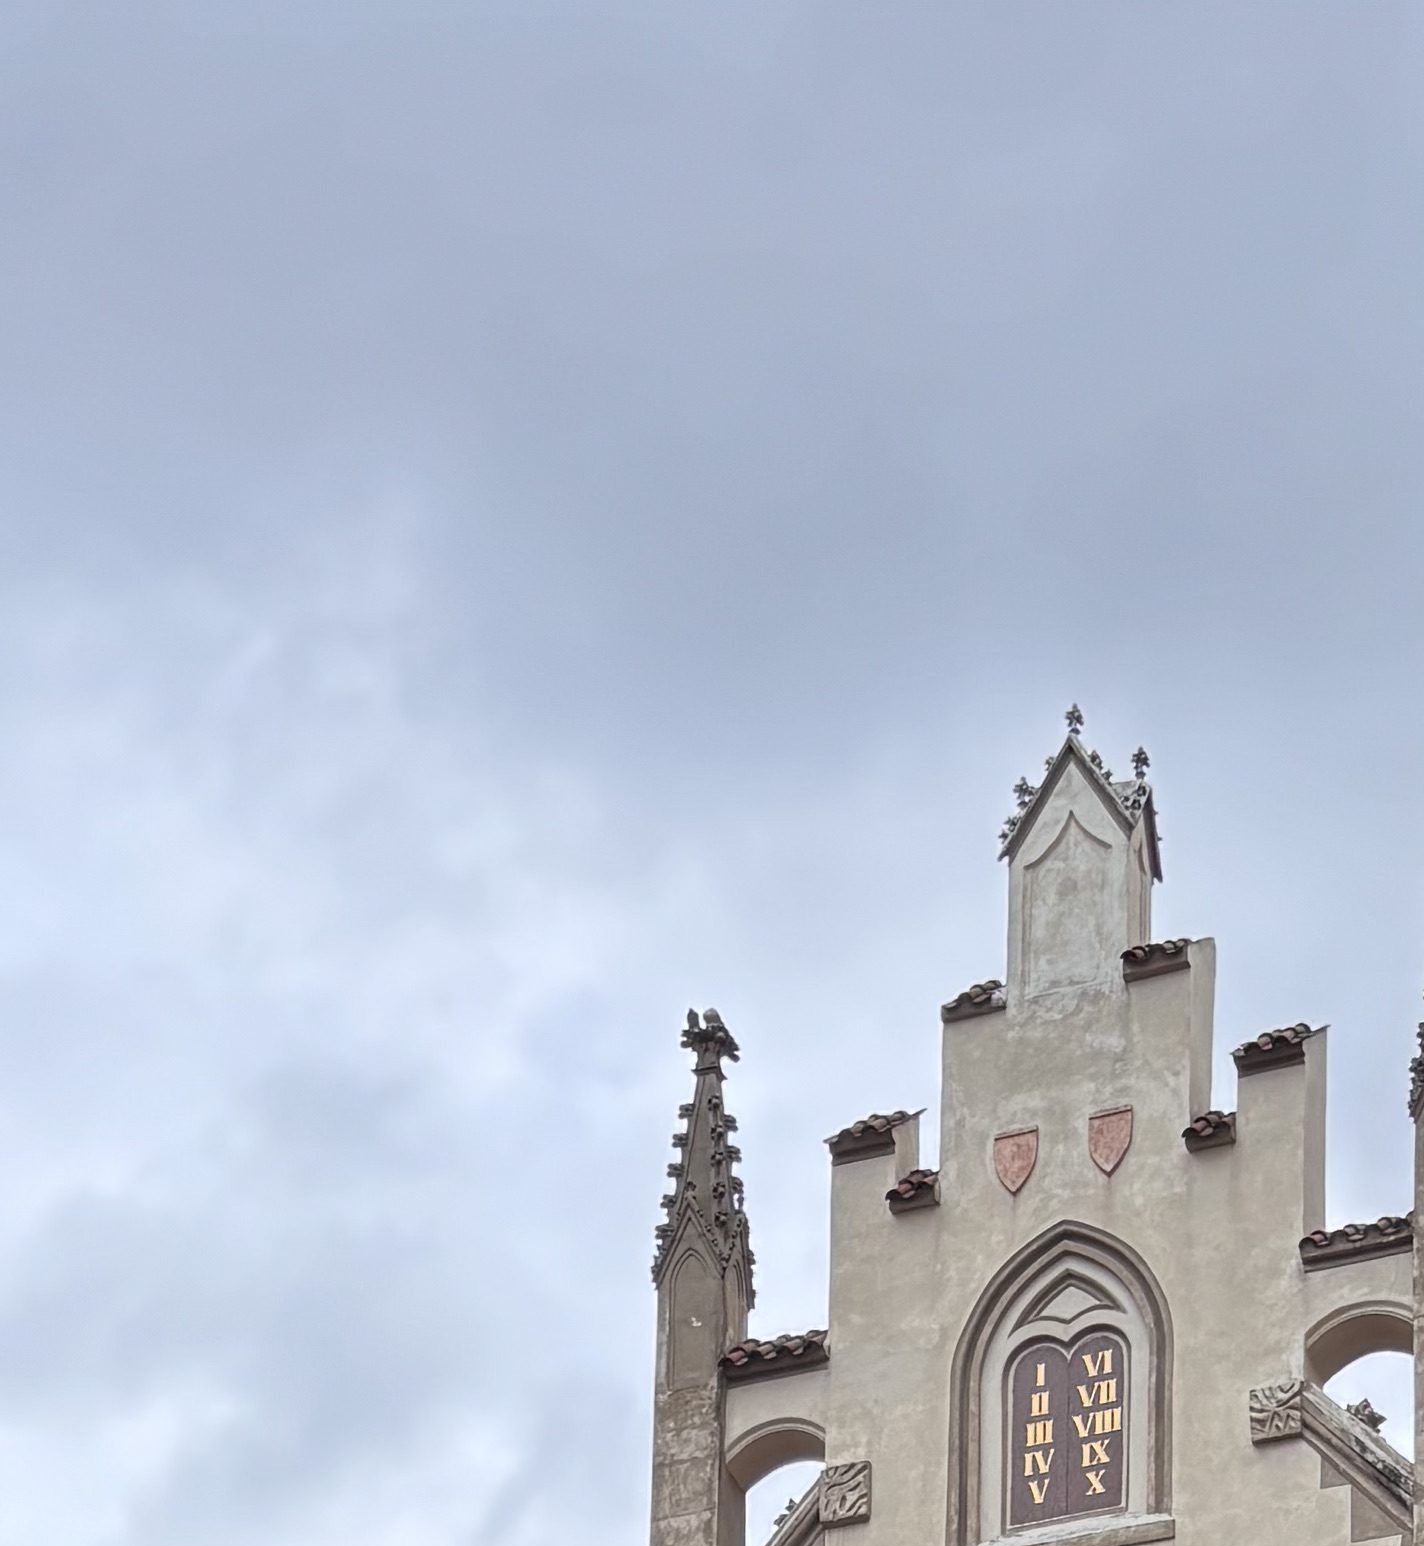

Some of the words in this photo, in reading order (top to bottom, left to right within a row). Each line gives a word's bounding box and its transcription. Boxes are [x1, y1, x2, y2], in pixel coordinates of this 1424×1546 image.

[1036, 1363, 1046, 1386] I
[1082, 1349, 1113, 1377] VI
[1031, 1391, 1050, 1416] II
[1077, 1378, 1117, 1407] VII
[1026, 1419, 1054, 1446] III
[1072, 1407, 1122, 1437] VIII
[1023, 1449, 1055, 1476] IV
[1081, 1439, 1111, 1467] IX
[1028, 1479, 1051, 1504] V
[1085, 1470, 1106, 1495] X
